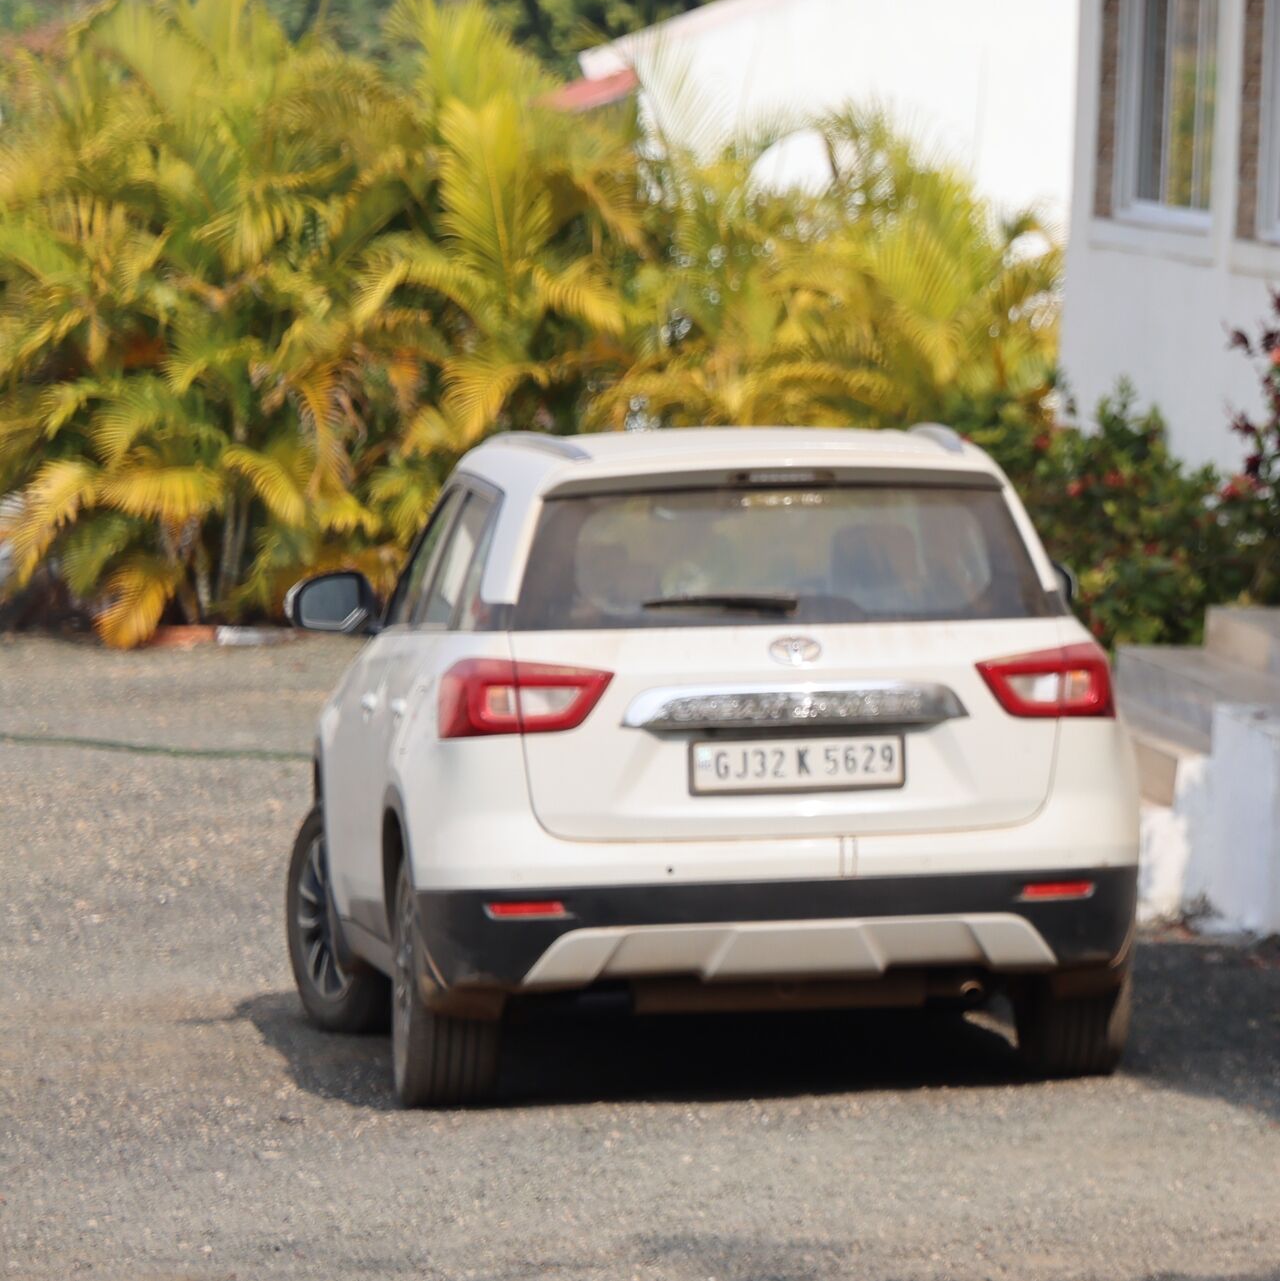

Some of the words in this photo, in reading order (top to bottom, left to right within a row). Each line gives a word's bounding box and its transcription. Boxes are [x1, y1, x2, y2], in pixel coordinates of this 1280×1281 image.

[715, 749, 787, 779] GJ32
[796, 749, 810, 775] K
[825, 745, 894, 775] 5629
